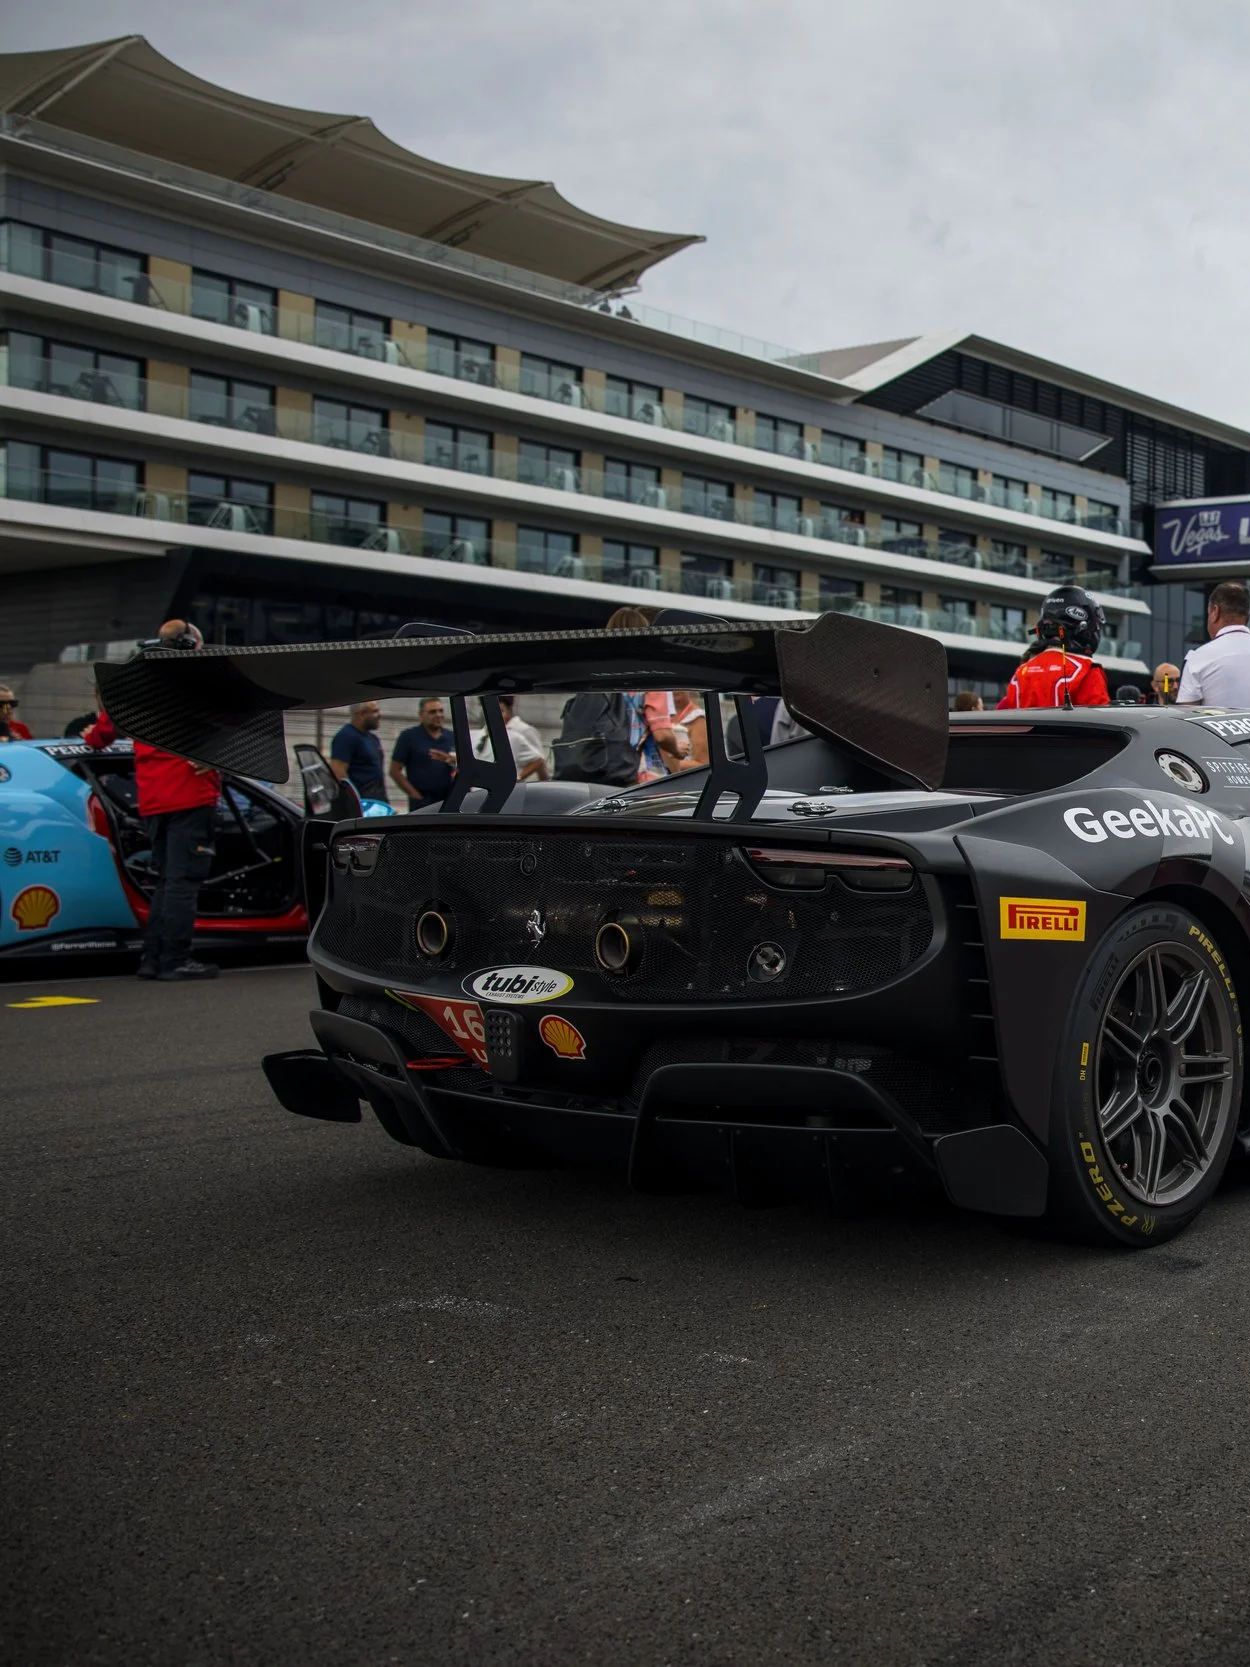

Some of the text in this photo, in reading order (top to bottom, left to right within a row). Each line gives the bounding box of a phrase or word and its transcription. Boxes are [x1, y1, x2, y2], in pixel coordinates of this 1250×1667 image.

[1163, 514, 1230, 556] Vegas
[1063, 800, 1234, 845] GeekaPC
[25, 850, 61, 864] AT&T
[1008, 904, 1079, 931] PIRELLI
[482, 973, 557, 994] tubi style
[443, 1006, 486, 1042] 16
